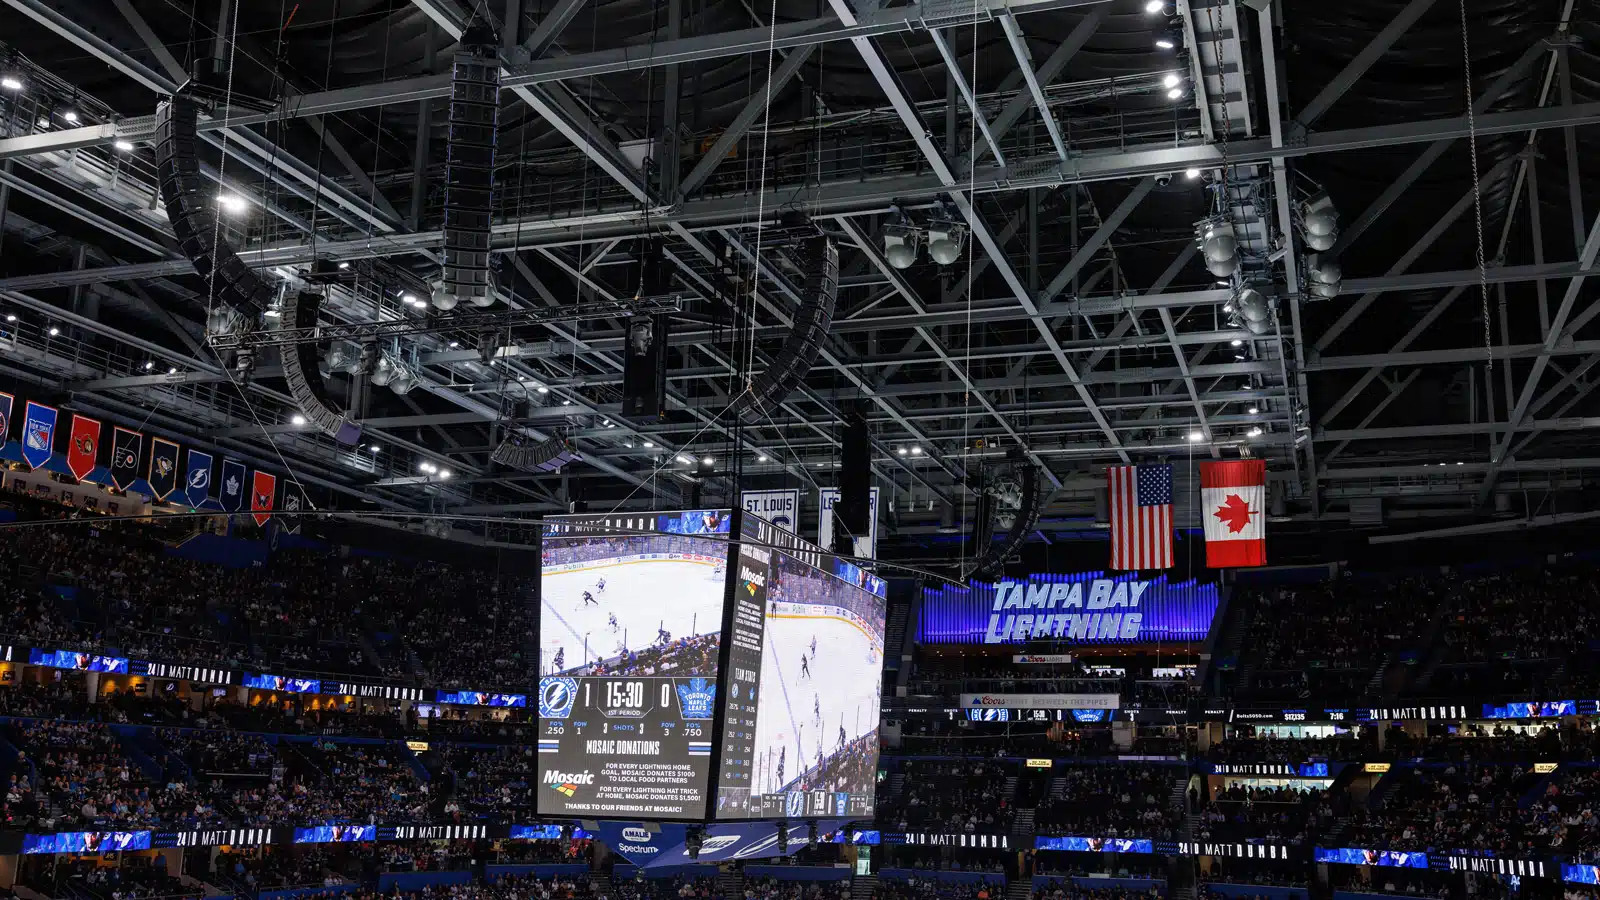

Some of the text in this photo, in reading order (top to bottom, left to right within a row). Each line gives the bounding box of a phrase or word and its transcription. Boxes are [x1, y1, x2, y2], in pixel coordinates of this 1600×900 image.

[747, 498, 792, 511] ST. LOUIS
[741, 566, 765, 586] Mosaic
[992, 580, 1149, 610] TAMPA BAY
[984, 613, 1142, 643] LIGHTNING
[169, 665, 192, 679] MATT
[194, 667, 231, 684] DUMBA
[735, 668, 744, 680] TEAM
[361, 685, 382, 697] MATT
[386, 687, 424, 701] DUMBA
[585, 684, 590, 707] 1
[606, 682, 643, 708] 15:30
[661, 684, 670, 708] 0
[685, 693, 711, 702] TORONTO
[982, 696, 1006, 705] Coors
[1018, 710, 1021, 720] 1
[1057, 710, 1061, 720] 0
[1393, 708, 1416, 719] MATT
[1421, 706, 1466, 719] DUMBA
[603, 723, 608, 734] 3
[640, 723, 644, 734] 3
[586, 740, 660, 755] MOSAIC DONATIONS
[1232, 765, 1252, 773] MATT
[543, 770, 595, 785] Mosaic
[201, 830, 227, 846] MATT
[230, 828, 272, 846] DUMBA
[419, 826, 443, 839] MATT
[446, 826, 486, 839] DUMBA
[624, 830, 649, 838] AMALIE
[930, 834, 956, 846] MATT
[961, 834, 1008, 848] DUMBA
[618, 843, 657, 854] Spectrum
[1205, 843, 1231, 856] MATT
[1237, 844, 1288, 859] DUMBA
[1472, 857, 1495, 873] MATT
[1499, 858, 1545, 877] DUMBA
